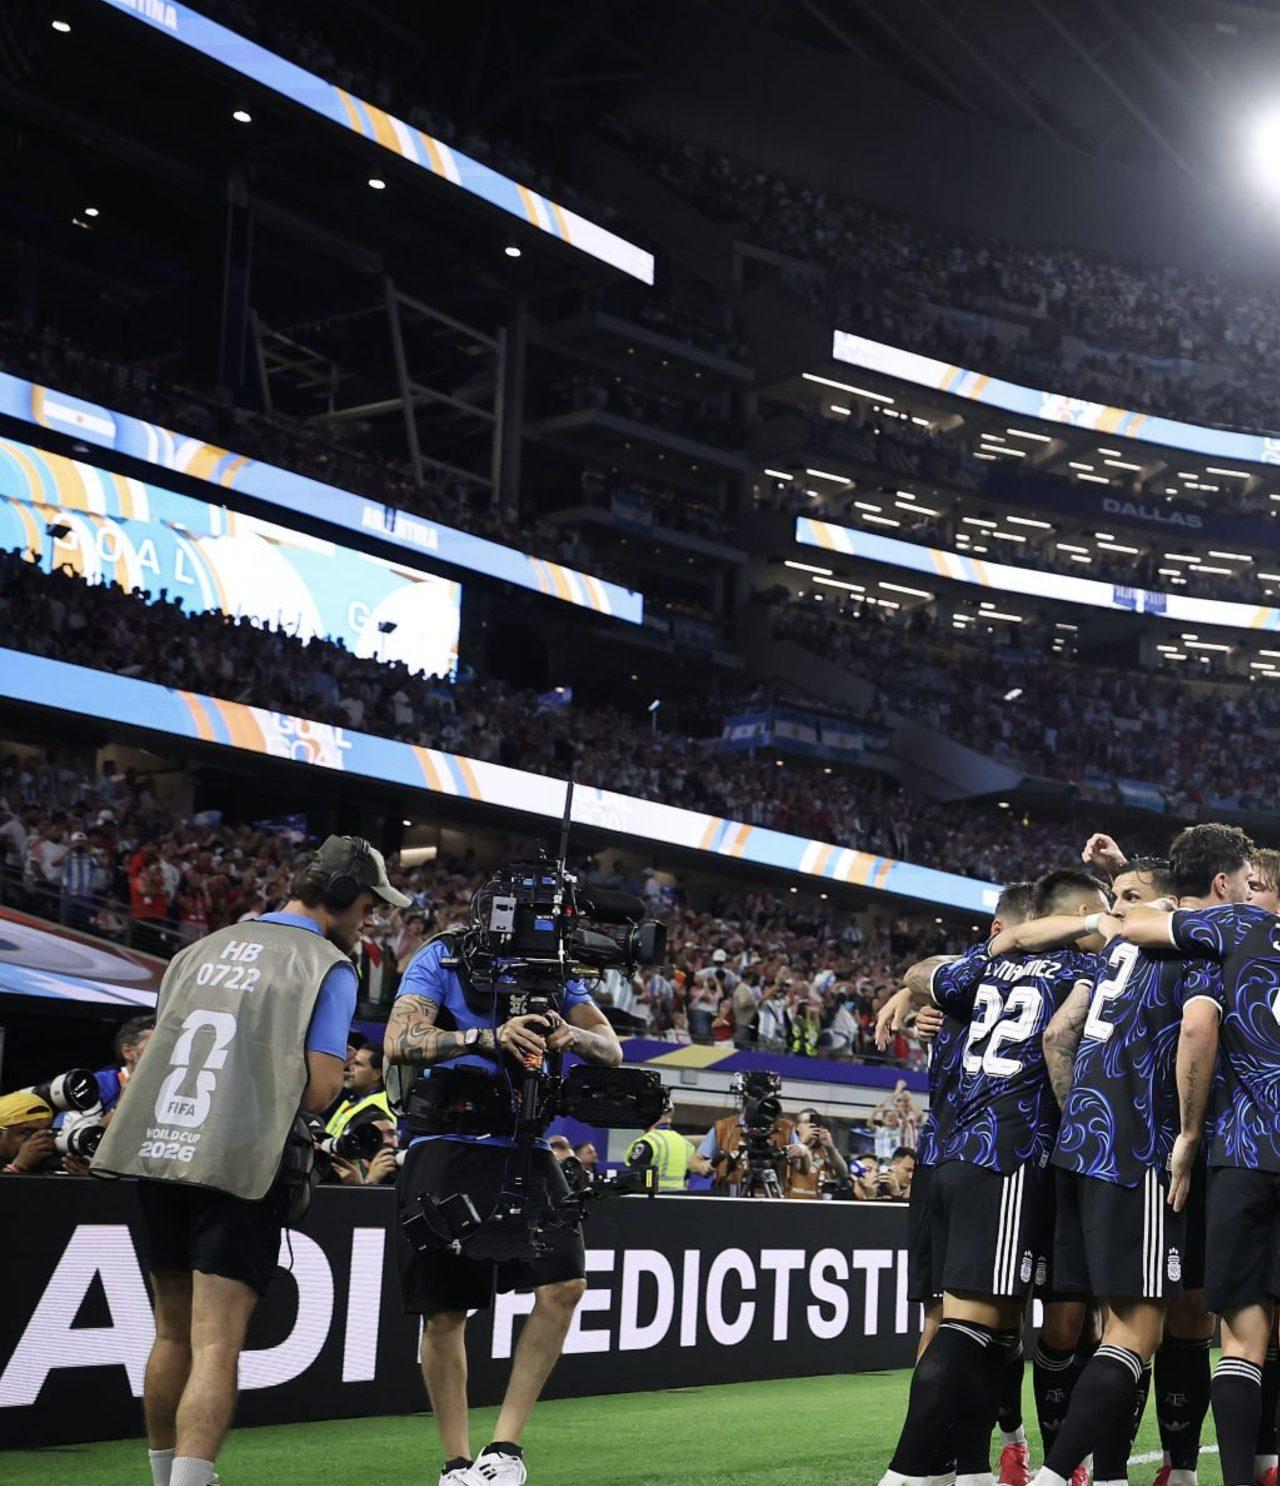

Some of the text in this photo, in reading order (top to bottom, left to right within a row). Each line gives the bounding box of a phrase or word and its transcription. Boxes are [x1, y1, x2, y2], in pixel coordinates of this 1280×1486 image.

[1103, 499, 1203, 528] DALLAS
[220, 940, 264, 962] HB
[196, 963, 261, 992] 0722
[1084, 942, 1139, 1043] 2
[962, 984, 1044, 1079] 22
[167, 1101, 195, 1118] FIFA
[146, 1127, 201, 1144] WORLD CUP
[138, 1141, 196, 1163] 2026
